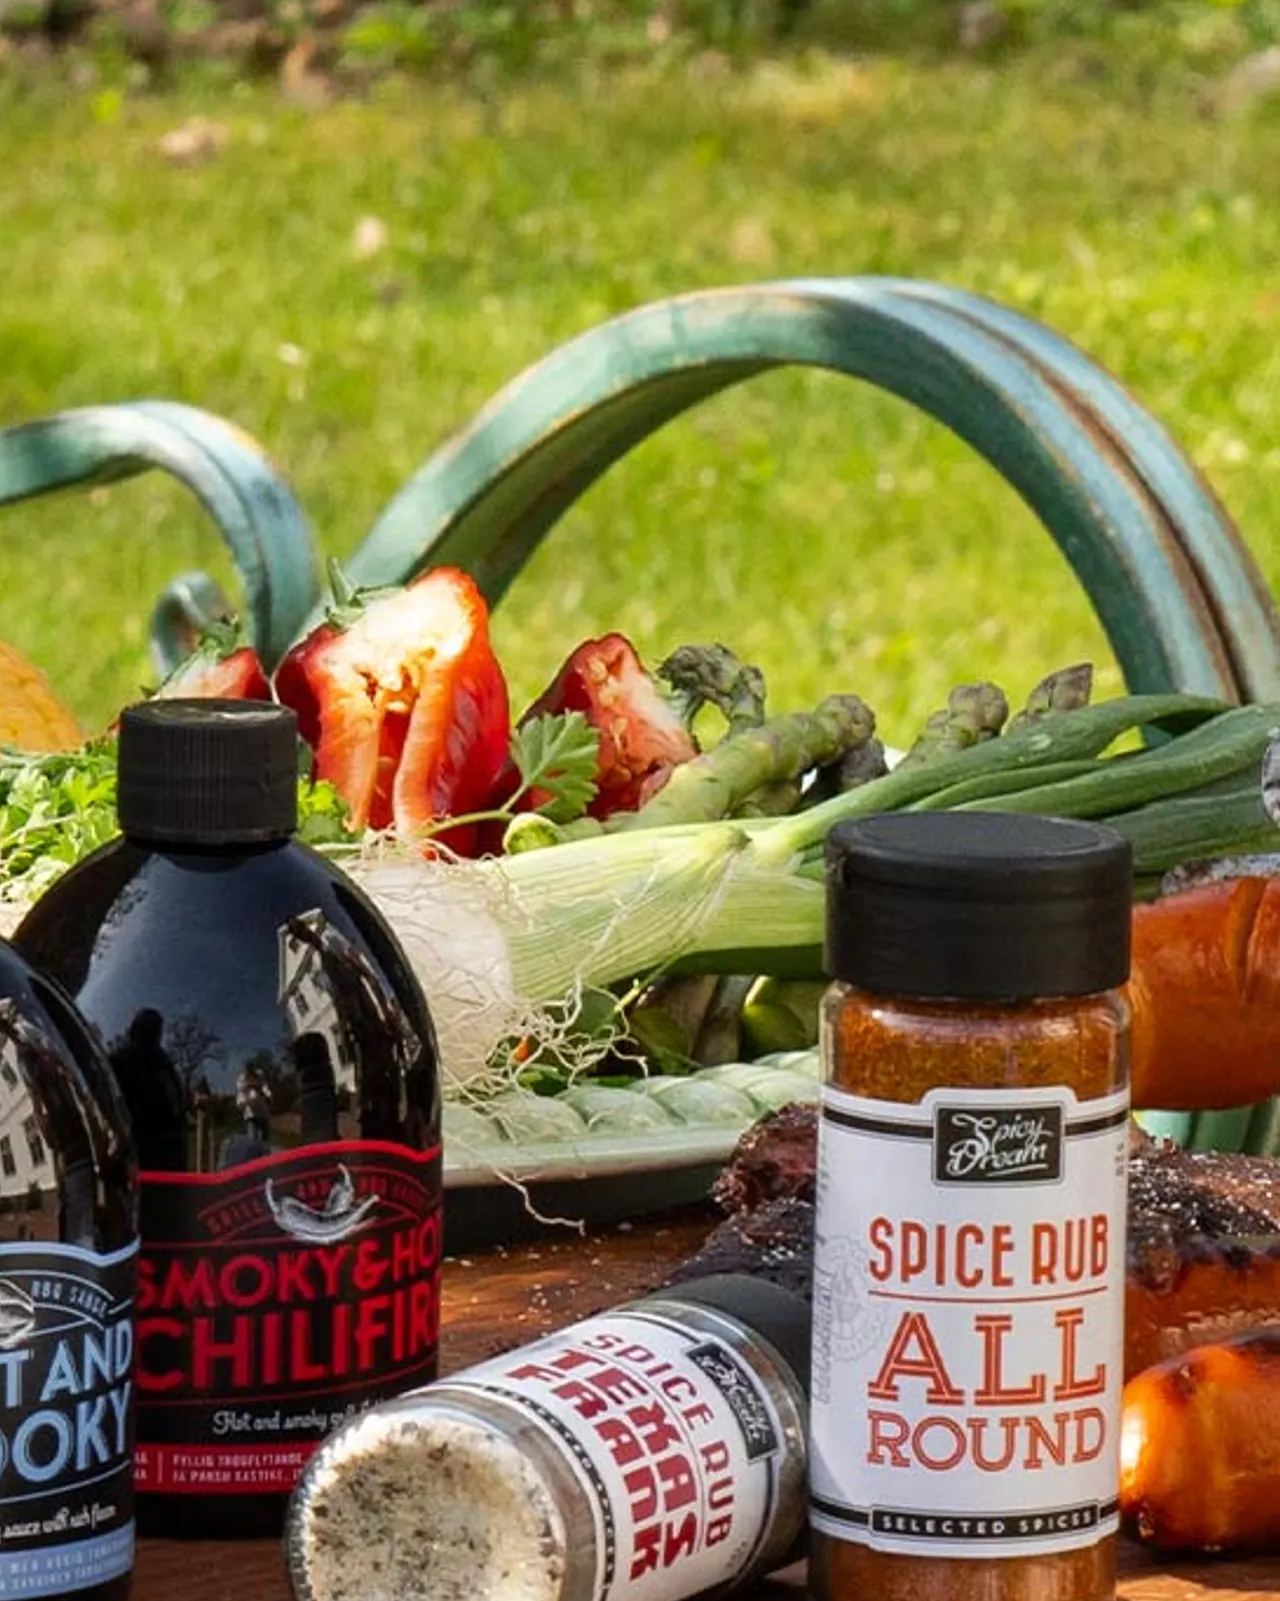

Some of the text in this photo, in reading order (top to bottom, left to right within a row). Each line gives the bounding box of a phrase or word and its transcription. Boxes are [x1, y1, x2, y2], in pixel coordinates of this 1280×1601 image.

[946, 1139, 1048, 1176] Dream
[950, 1111, 1054, 1149] Spicy
[868, 1213, 1110, 1288] SPICE RUB
[39, 1318, 134, 1403] AND
[136, 1274, 440, 1390] CHILIFIR
[867, 1306, 1107, 1407] ALL
[253, 1409, 280, 1430] and
[582, 1333, 736, 1549] SPICE RUB
[867, 1407, 1106, 1472] ROUND
[547, 1347, 698, 1569] TEXAS
[881, 1510, 1093, 1536] SELECTED SPICES
